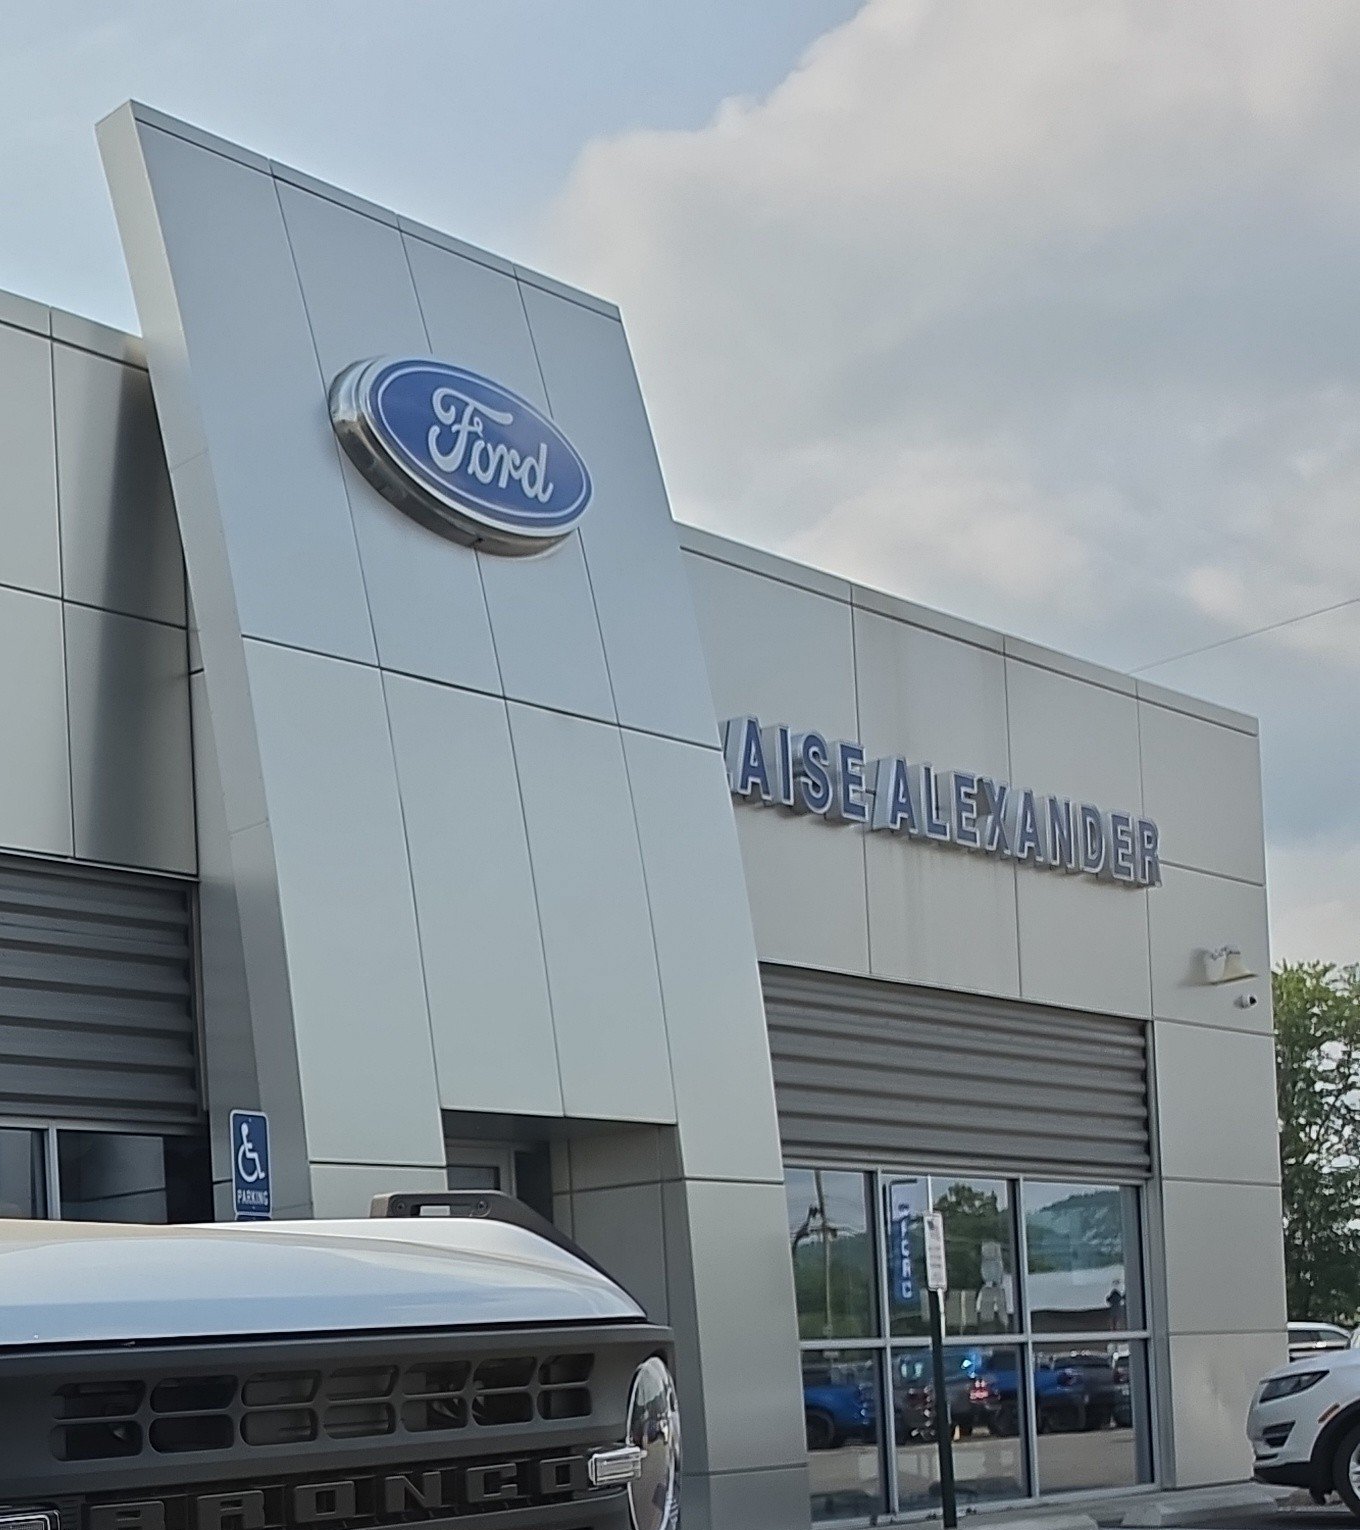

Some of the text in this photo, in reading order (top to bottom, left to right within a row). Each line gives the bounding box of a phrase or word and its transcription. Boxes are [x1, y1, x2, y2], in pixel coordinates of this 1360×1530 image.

[428, 387, 554, 503] Ford
[726, 714, 1162, 887] AISE ALEXANDER
[237, 1189, 269, 1206] PARKING
